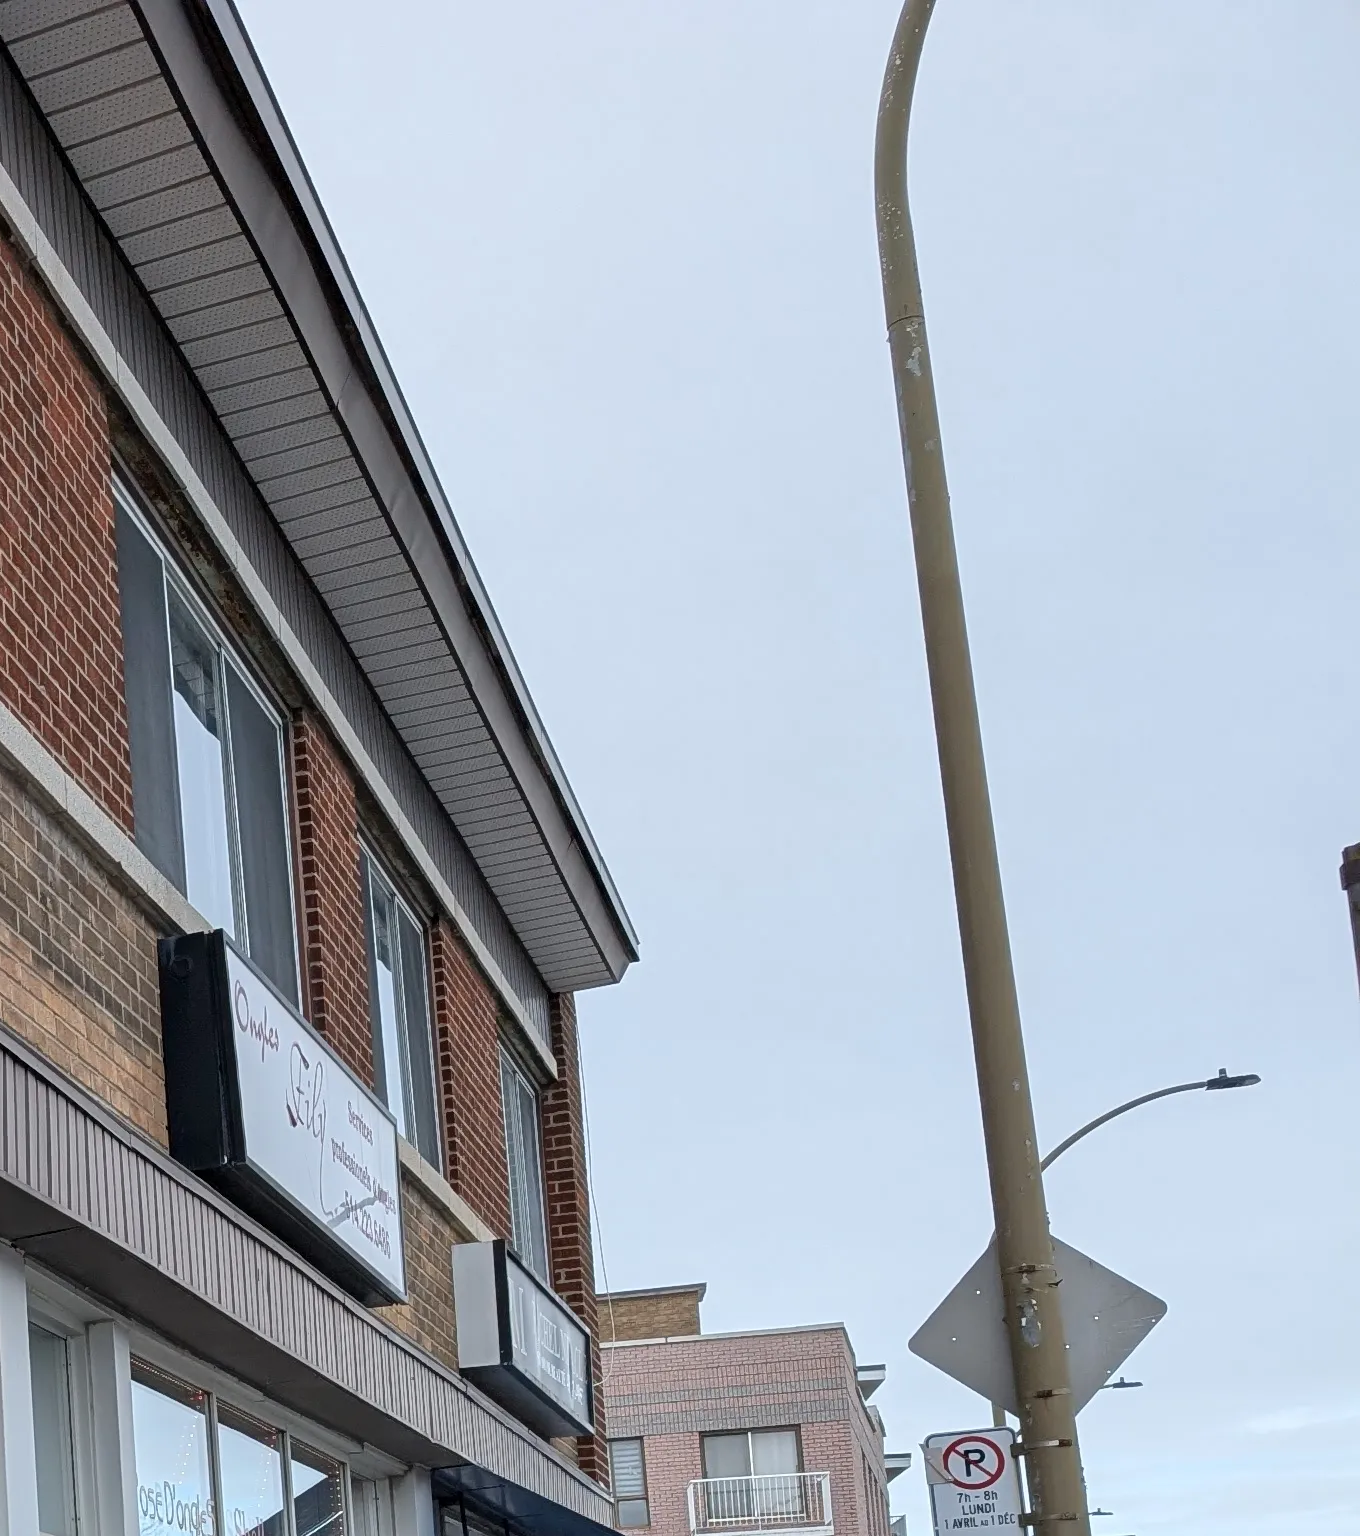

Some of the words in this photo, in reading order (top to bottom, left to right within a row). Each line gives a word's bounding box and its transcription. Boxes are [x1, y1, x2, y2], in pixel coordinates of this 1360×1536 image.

[957, 1492, 971, 1503] 7h
[983, 1490, 998, 1501] 8h
[961, 1502, 996, 1516] LUNDI
[944, 1519, 949, 1530] 1
[952, 1515, 979, 1528] AVRIL
[991, 1514, 996, 1526] 1
[998, 1511, 1016, 1525] DÉC
